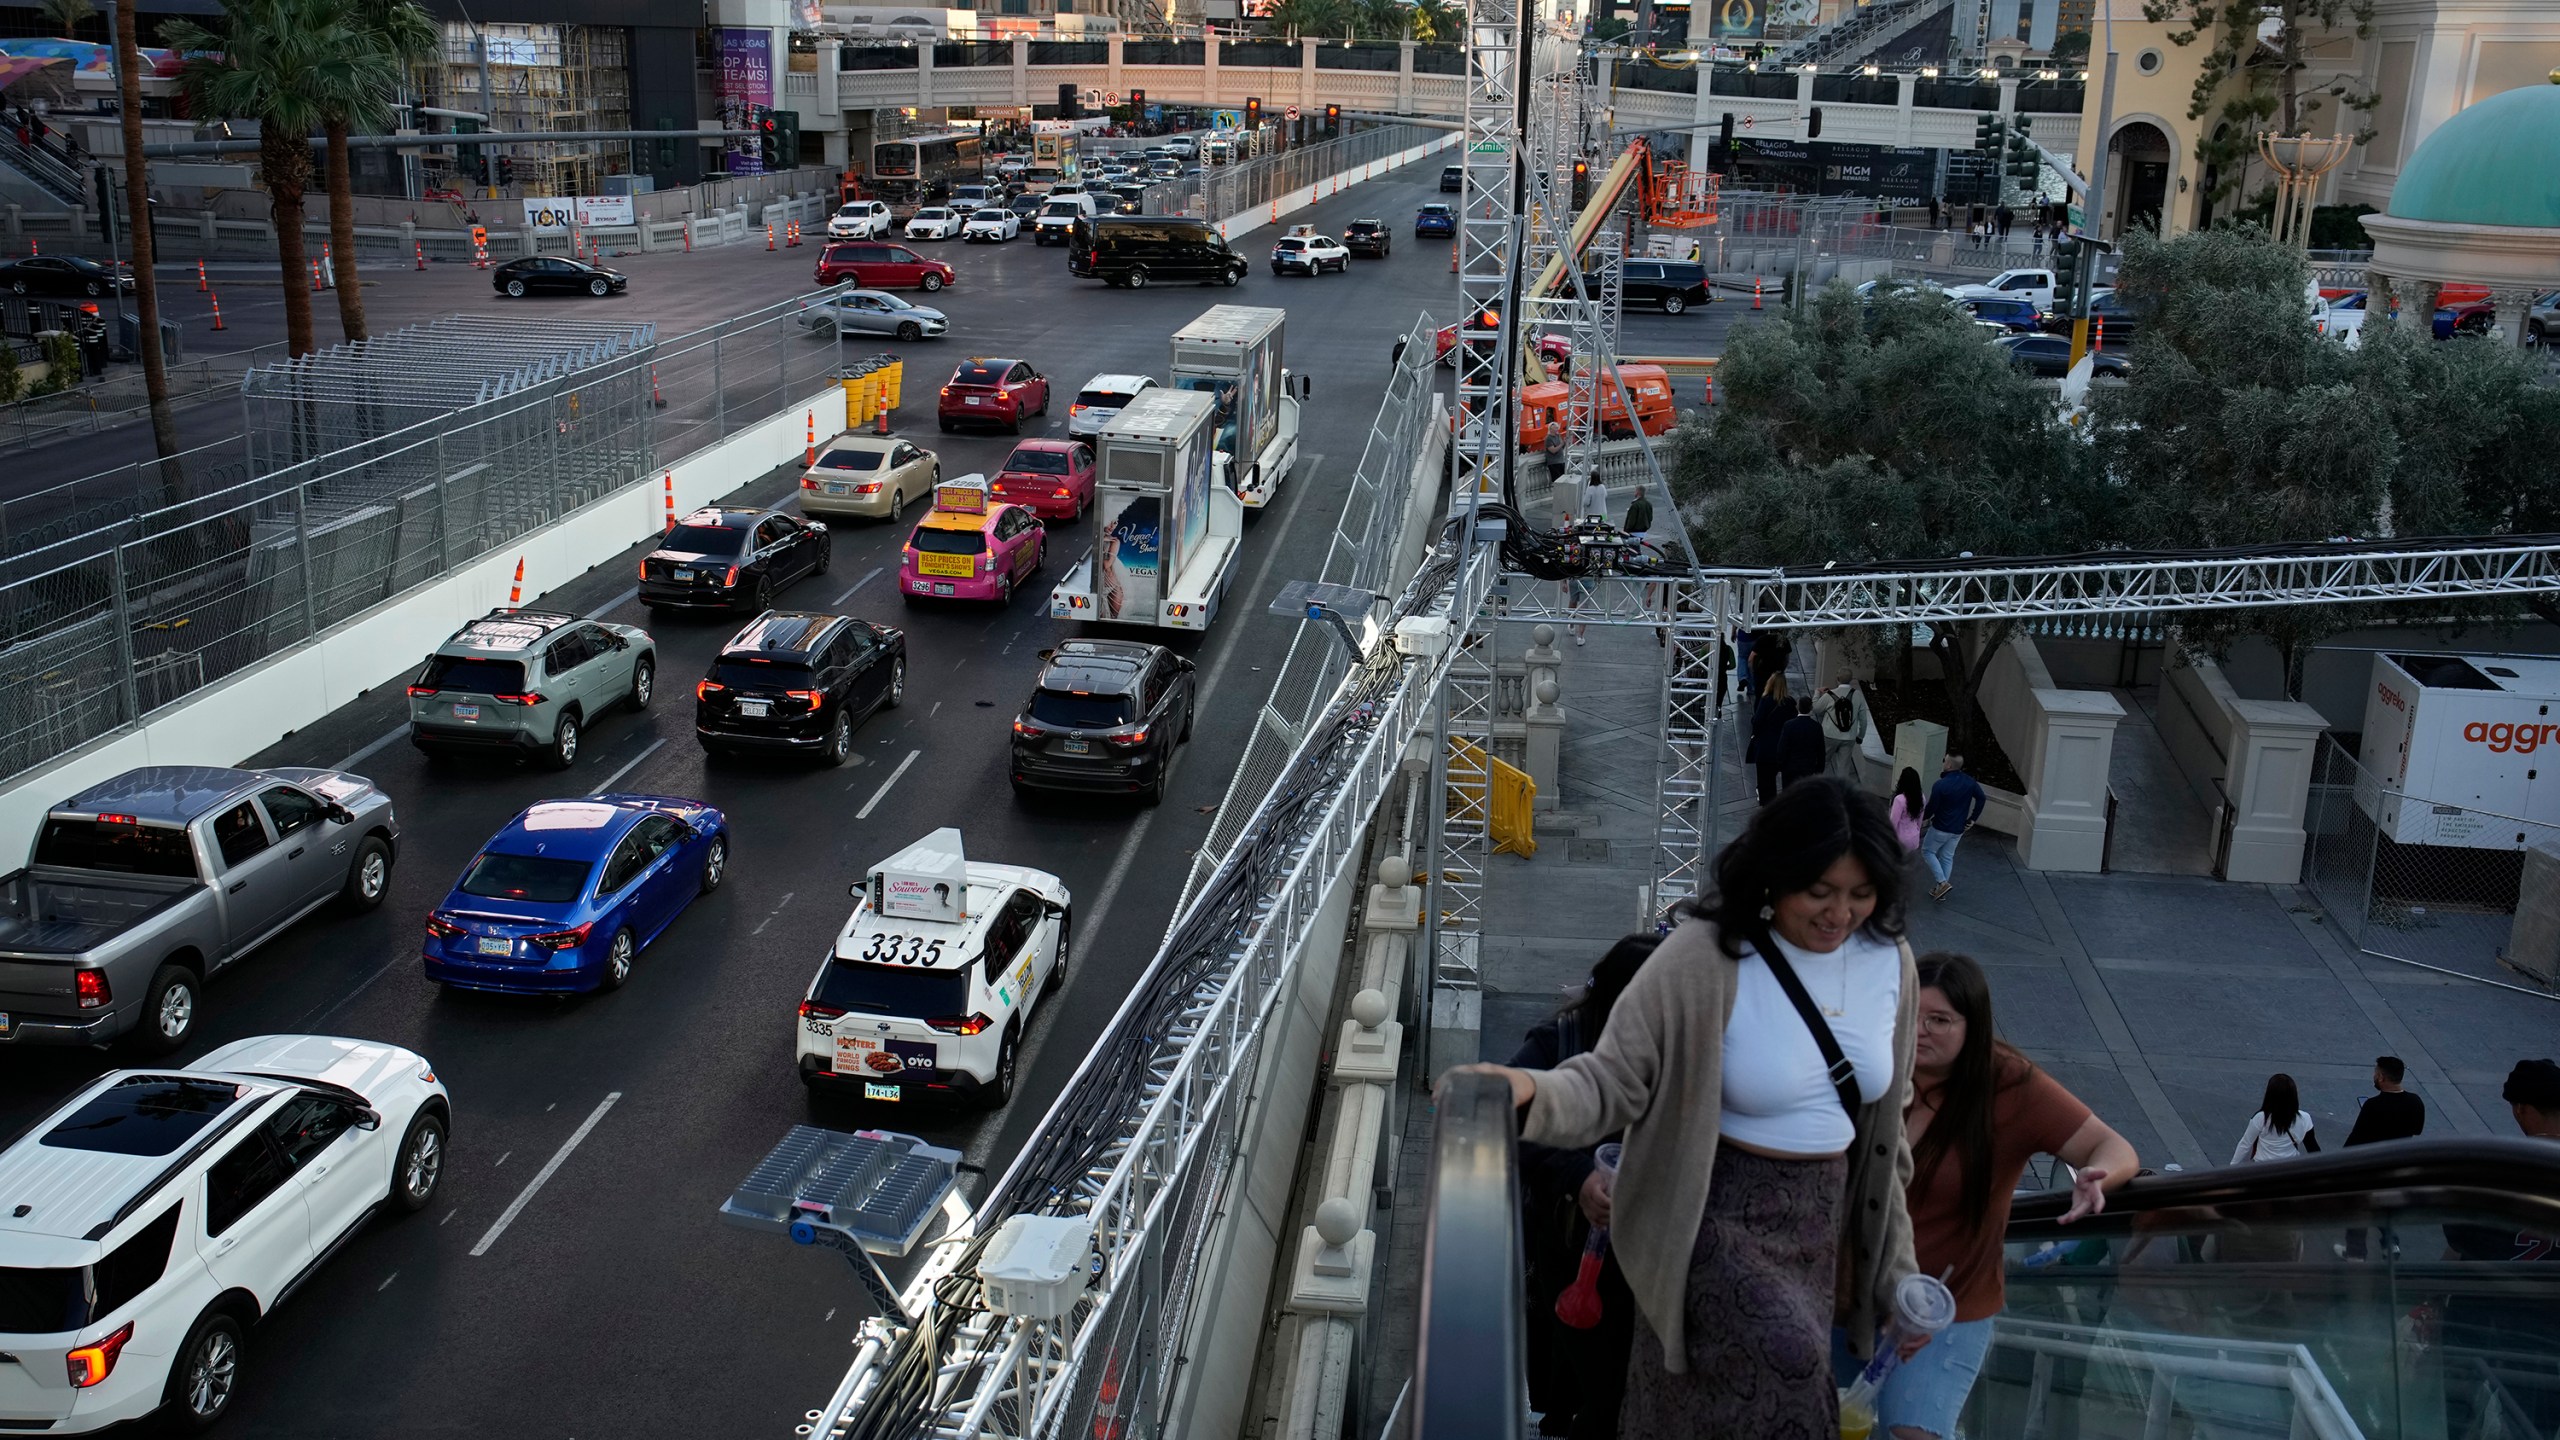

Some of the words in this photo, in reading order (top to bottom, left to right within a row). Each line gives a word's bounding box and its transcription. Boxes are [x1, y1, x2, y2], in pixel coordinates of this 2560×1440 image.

[740, 39, 766, 48] VEGAS
[745, 57, 766, 69] ALL
[724, 69, 768, 81] TEAMS!
[1755, 140, 1788, 149] BELLAGIO
[1760, 149, 1808, 159] GRANDSTAND
[1842, 165, 1871, 175] MGM
[1891, 197, 1919, 207] MGM
[1474, 429, 1497, 439] MST
[1139, 544, 1159, 553] Show
[921, 554, 937, 562] BEST
[938, 555, 960, 563] PRICES
[962, 556, 972, 565] ON
[921, 561, 950, 569] TONIGHT'S
[928, 568, 963, 576] VEGAS.COM
[1129, 567, 1158, 576] VEGAS
[913, 581, 930, 591] 3296
[2378, 682, 2405, 712] aggreko
[2400, 705, 2414, 778] aggreko.com
[2463, 722, 2560, 754] aggr
[888, 881, 931, 894] Souvenir
[862, 932, 947, 968] 3335
[806, 1019, 833, 1037] 3335
[836, 1037, 877, 1050] HOOTERS
[836, 1051, 860, 1059] WORLD
[836, 1057, 860, 1065] FAMOUS
[907, 1056, 933, 1068] OYO
[836, 1063, 860, 1072] WINGS
